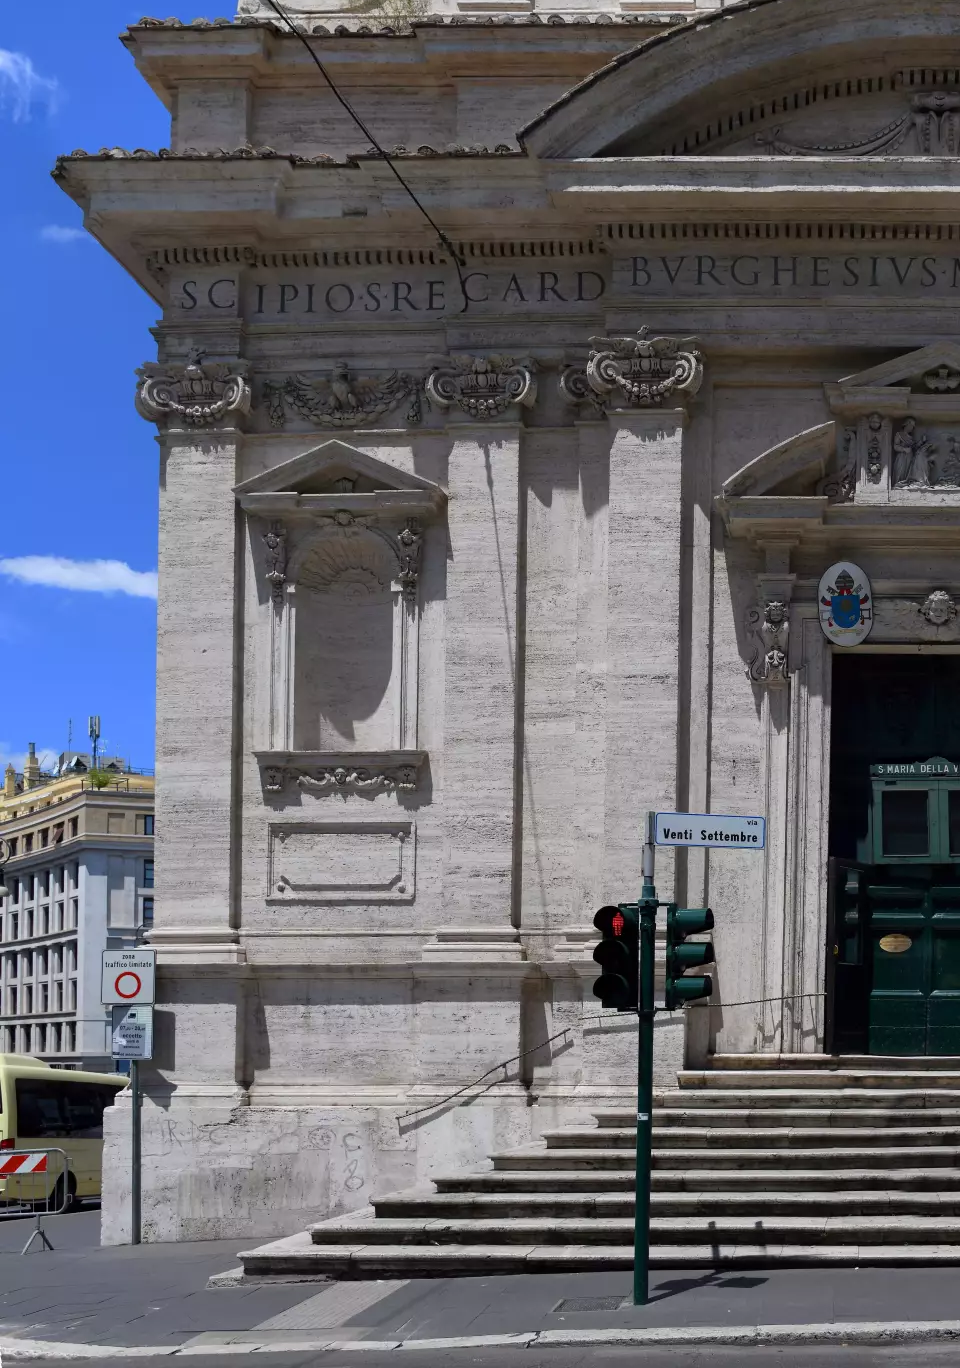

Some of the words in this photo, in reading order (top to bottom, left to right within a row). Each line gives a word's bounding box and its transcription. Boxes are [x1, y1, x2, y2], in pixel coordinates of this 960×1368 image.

[462, 271, 606, 303] CARD
[887, 765, 915, 774] MARIA
[920, 764, 950, 773] DELLA
[663, 828, 693, 840] Venti
[700, 829, 758, 843] Settembre
